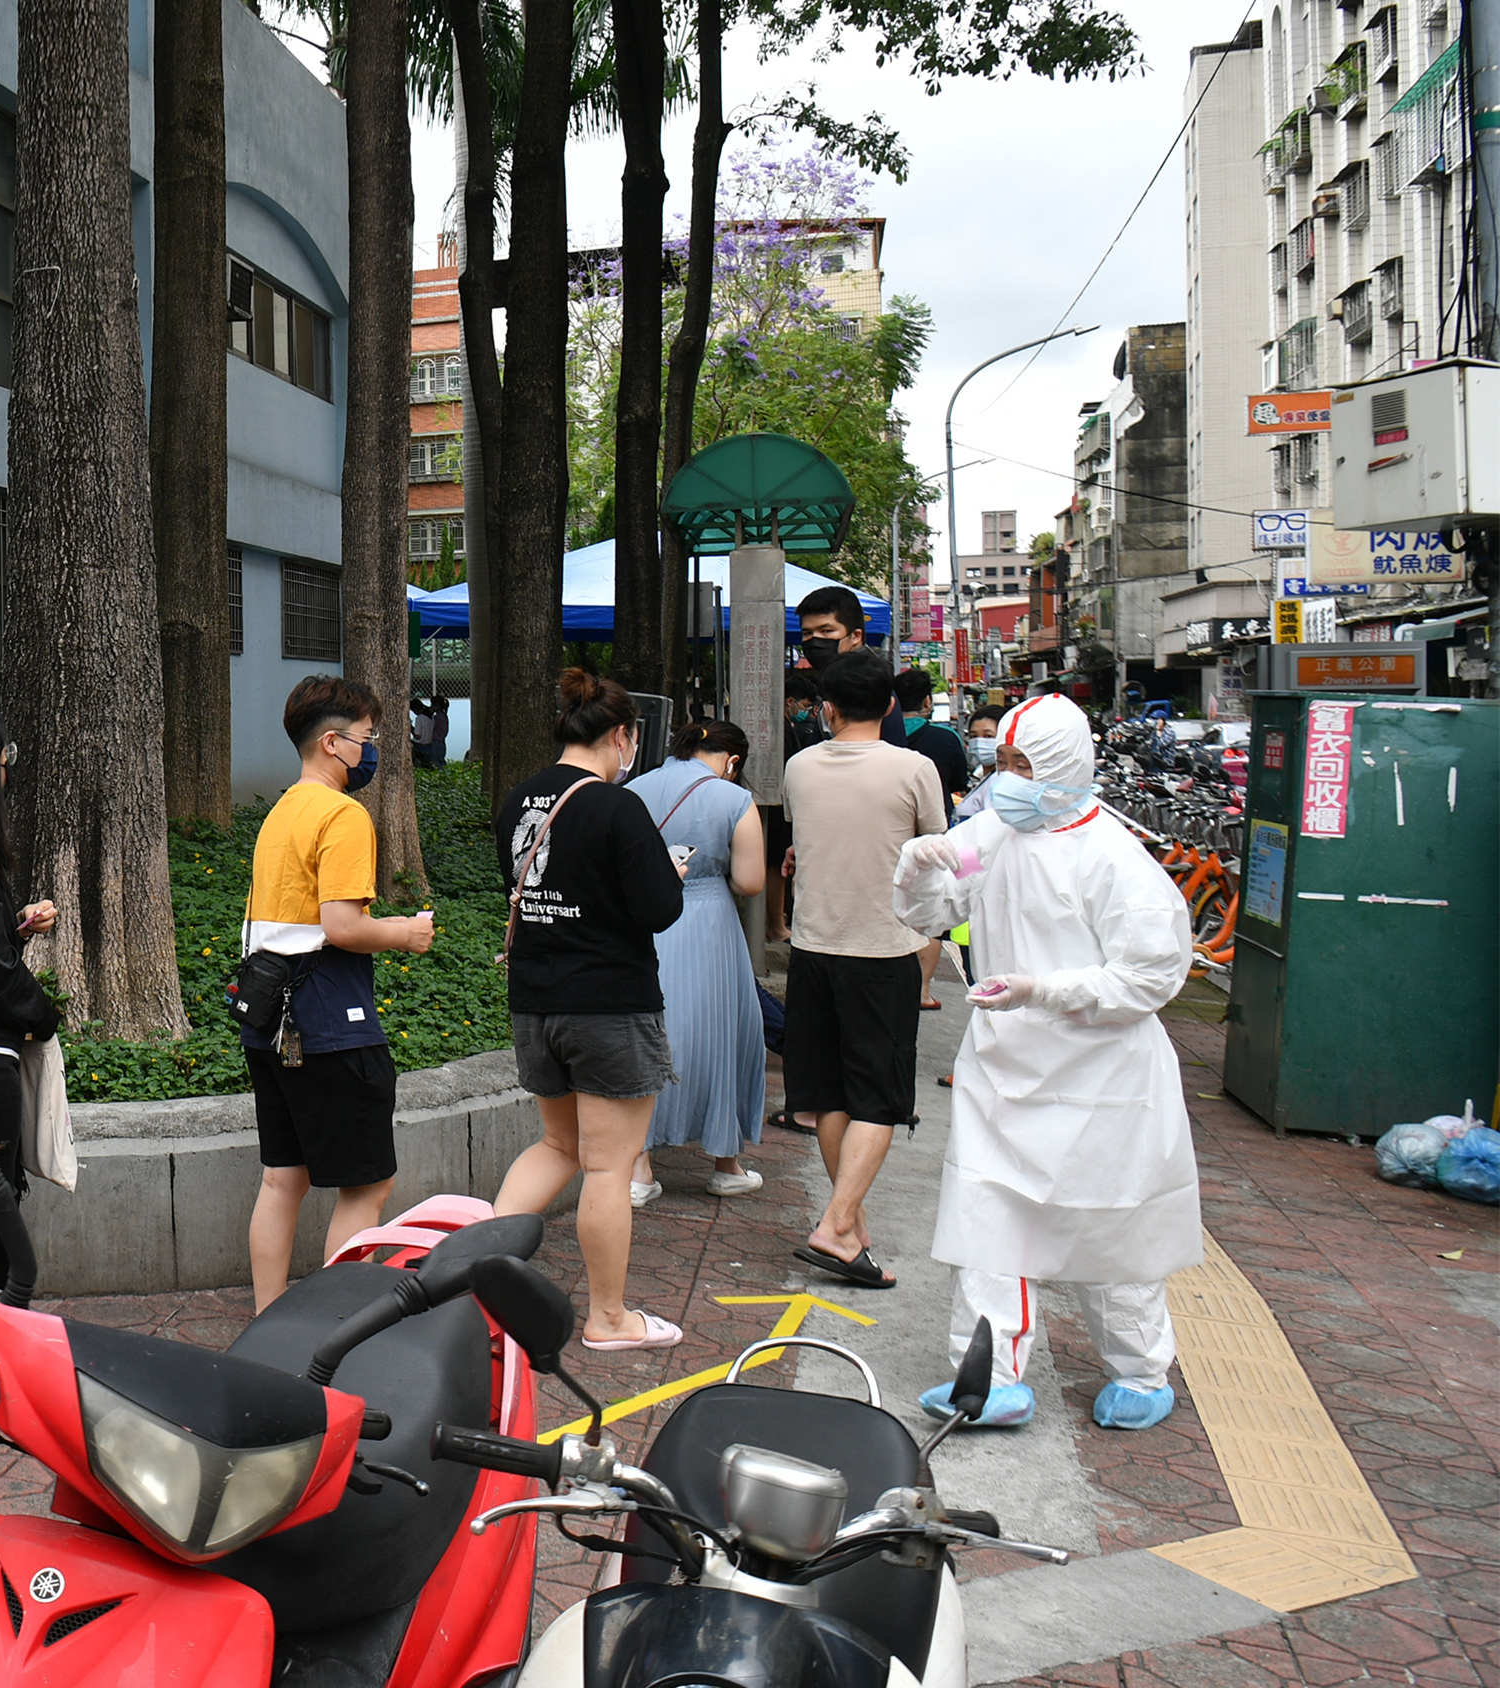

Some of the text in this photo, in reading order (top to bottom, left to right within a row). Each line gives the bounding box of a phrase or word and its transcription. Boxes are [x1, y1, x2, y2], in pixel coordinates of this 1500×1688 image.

[1373, 553, 1453, 575] 魷魚焿
[1315, 656, 1396, 672] 正義公園
[1364, 674, 1388, 686] Park
[522, 796, 531, 808] A
